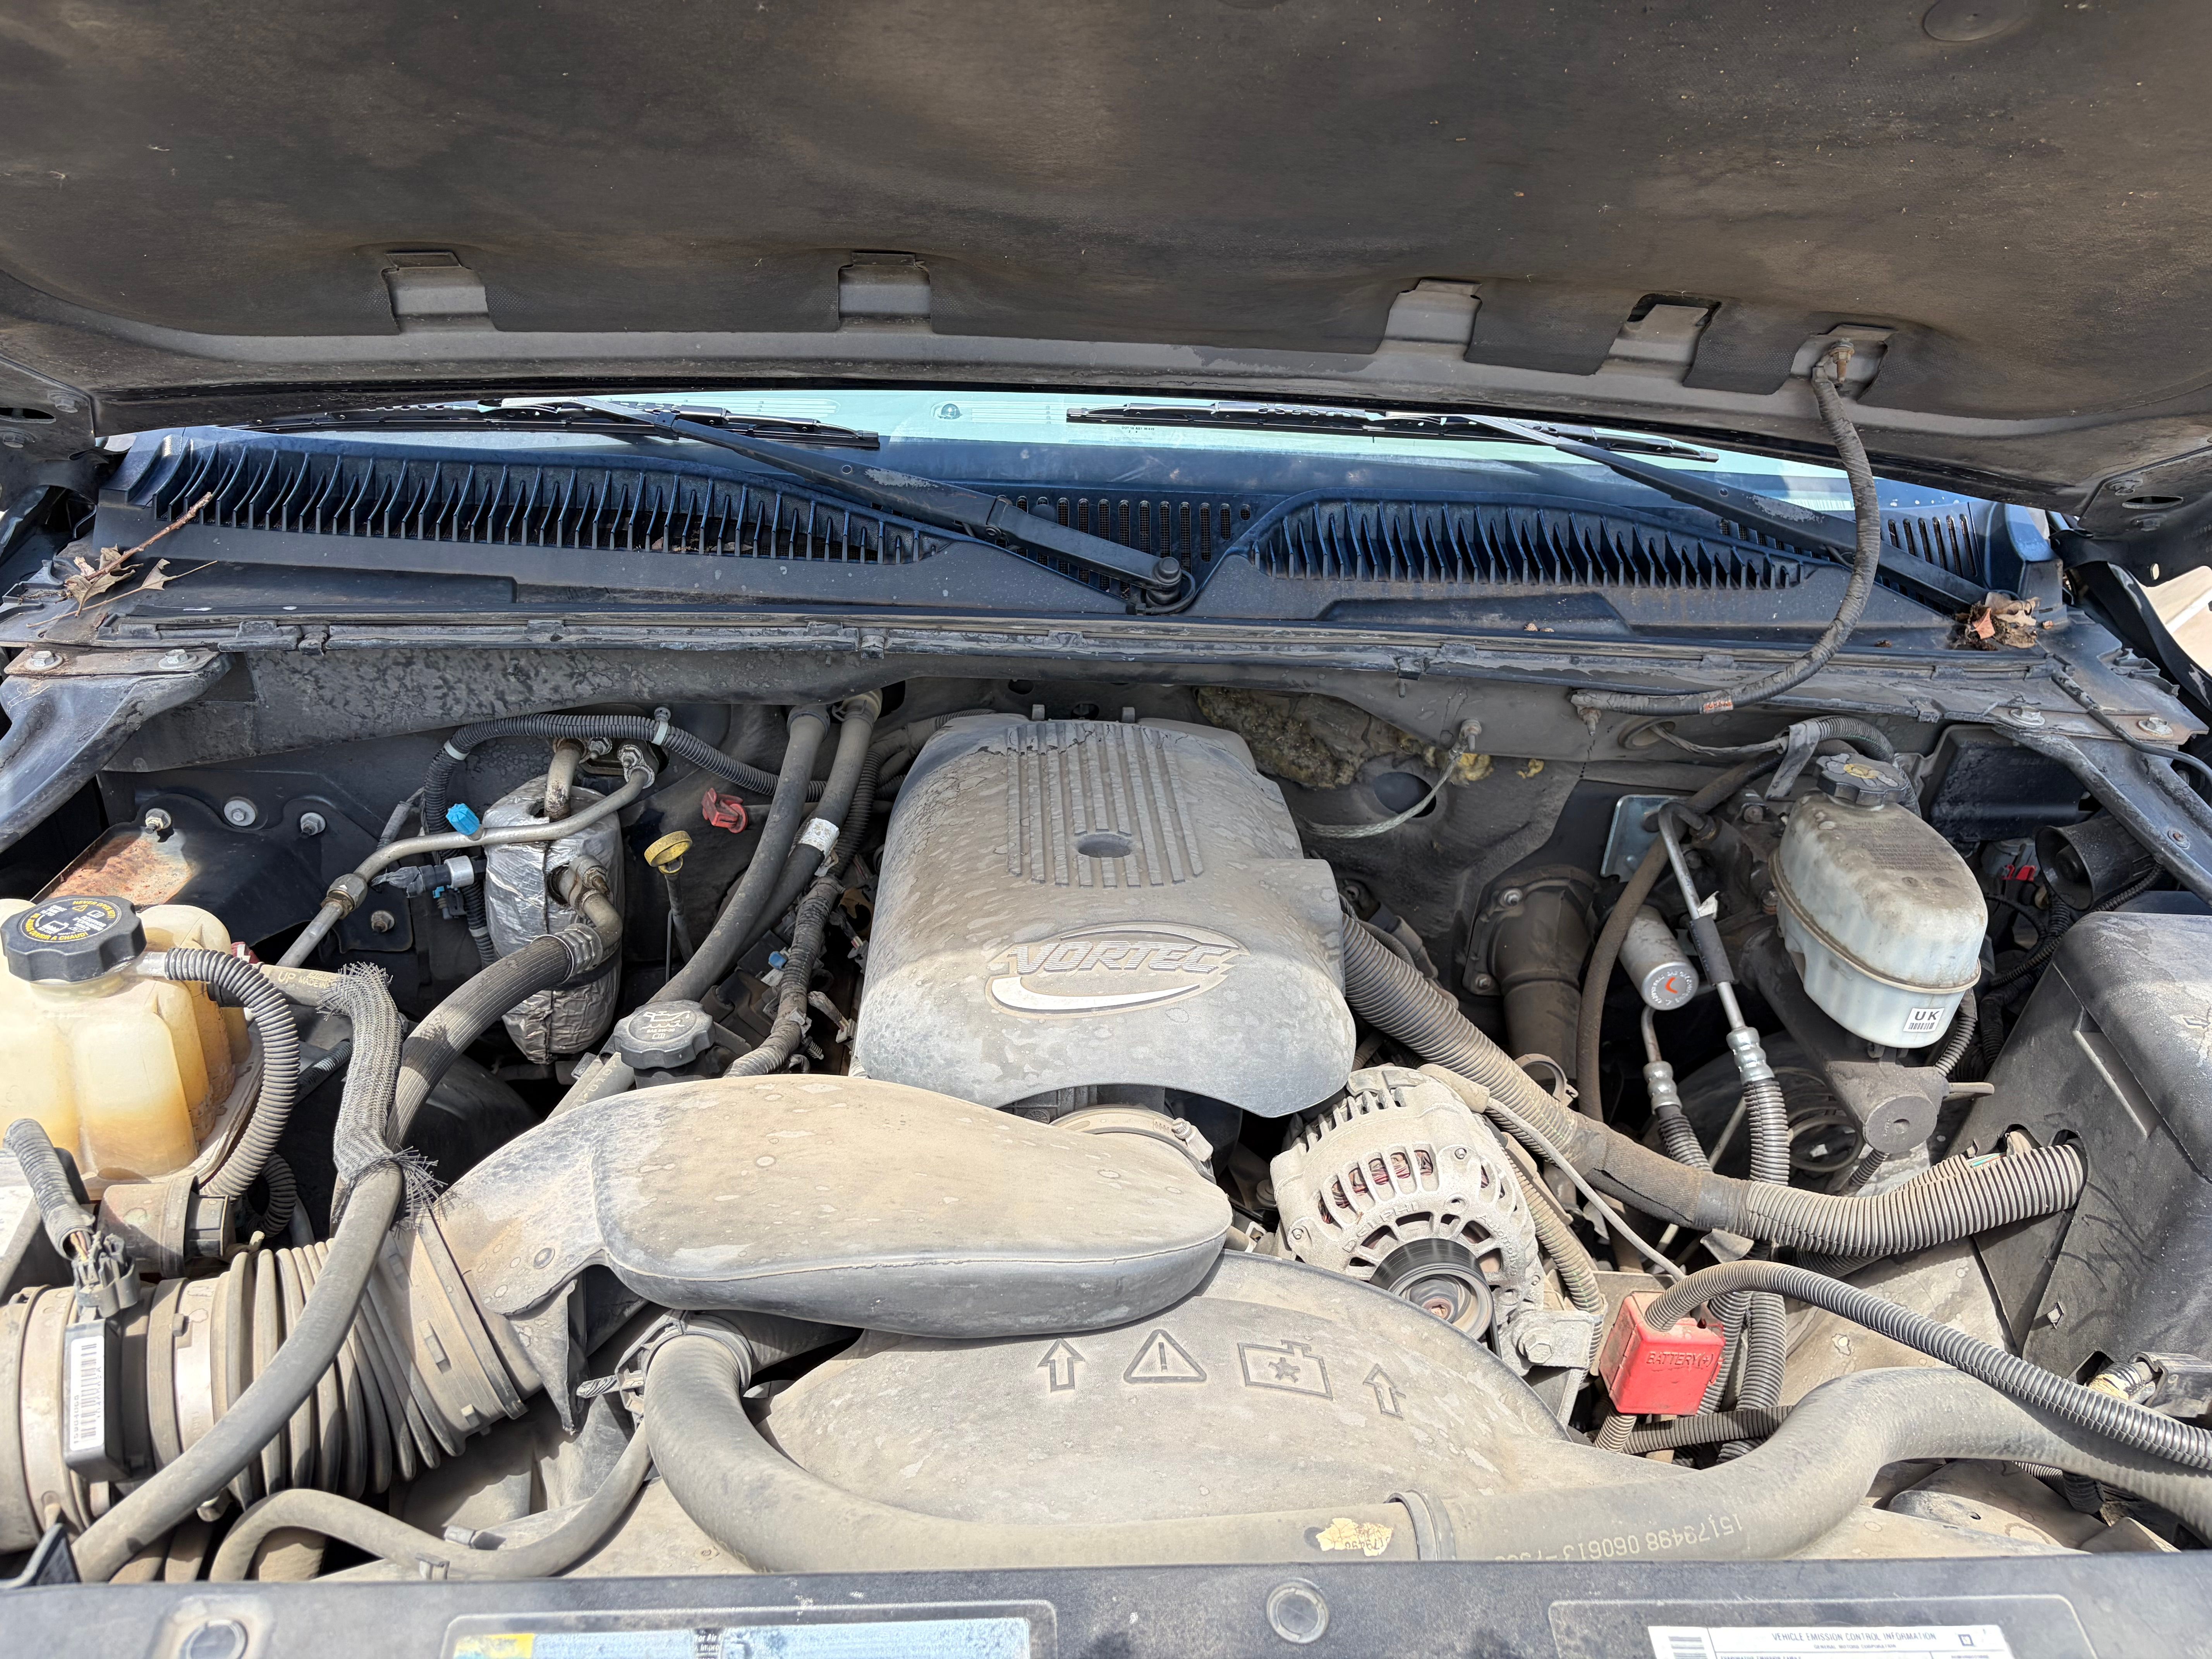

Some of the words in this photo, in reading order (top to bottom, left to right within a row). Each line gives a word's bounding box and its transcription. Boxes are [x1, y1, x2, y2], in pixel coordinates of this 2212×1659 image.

[1008, 940, 1232, 975] VORTEC
[1914, 1011, 1941, 1021] UK
[1342, 1201, 1418, 1253] DELPHI
[1645, 1513, 1742, 1551] 15179498
[1772, 1633, 1804, 1642] VEHICLE
[1806, 1633, 1843, 1642] EMISSION
[1845, 1632, 1879, 1641] CONTROL
[1882, 1632, 1937, 1641] INFORMATION
